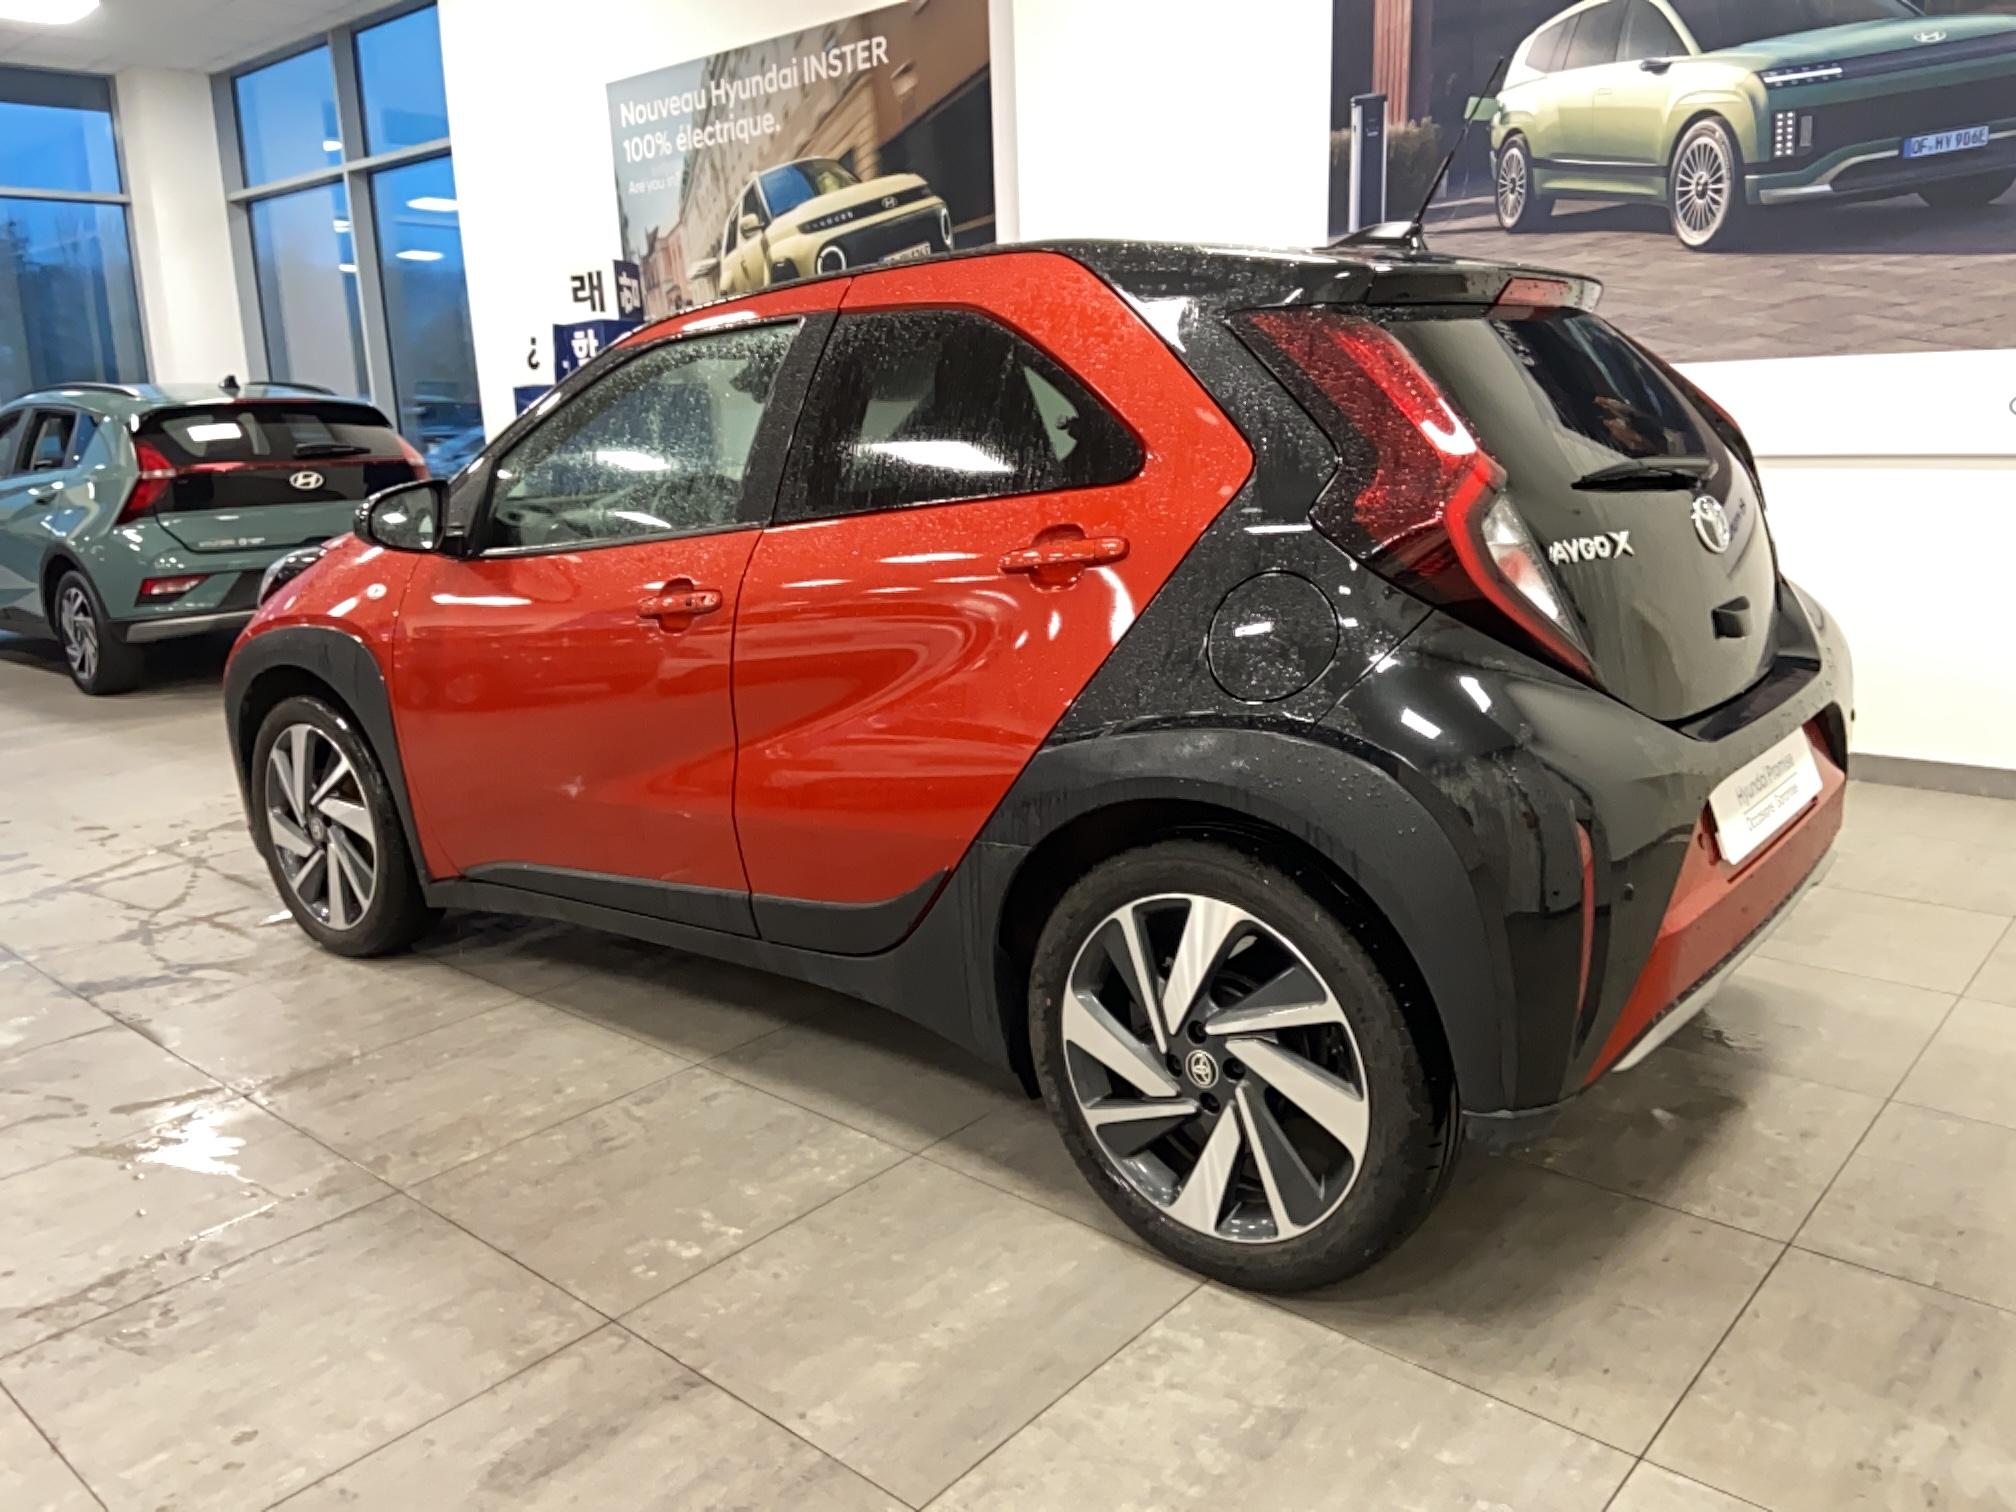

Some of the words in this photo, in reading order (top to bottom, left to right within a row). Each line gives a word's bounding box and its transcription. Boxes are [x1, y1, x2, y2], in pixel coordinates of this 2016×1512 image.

[620, 88, 707, 129] Nouveau
[710, 57, 799, 109] Hyundai
[803, 35, 889, 84] INSTER
[623, 129, 673, 163] 100%
[676, 112, 781, 152] électrique.
